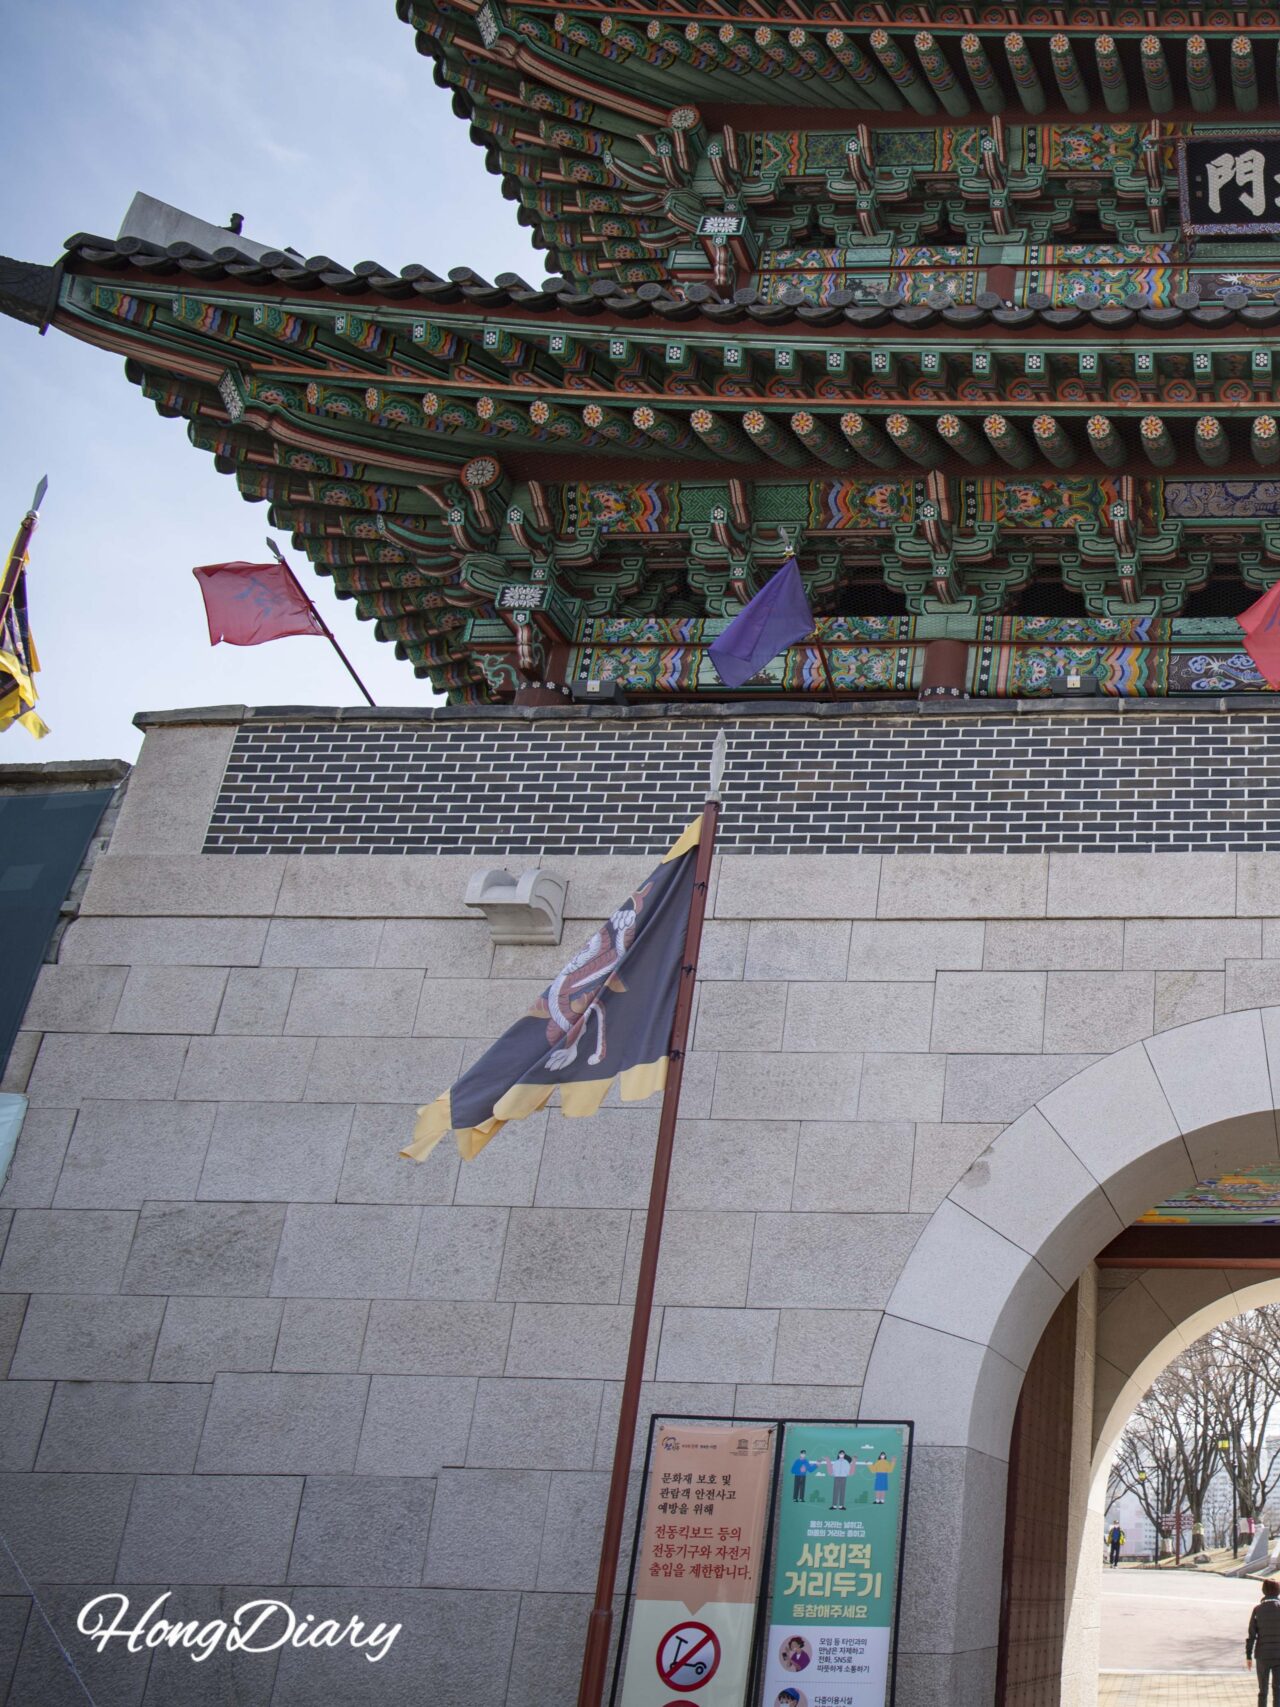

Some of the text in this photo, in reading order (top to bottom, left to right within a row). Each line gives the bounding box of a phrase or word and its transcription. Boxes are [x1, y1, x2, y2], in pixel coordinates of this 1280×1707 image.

[661, 1472, 732, 1486] 문화재 보호 및
[659, 1487, 736, 1501] 관람객 안전사고
[657, 1502, 714, 1515] 예방을 위해
[655, 1525, 742, 1542] 전동킥보드 등의
[652, 1543, 751, 1560] 전동기구와 자전거
[796, 1542, 872, 1569] 사회적
[649, 1562, 752, 1580] 출입을 제한합니다.
[783, 1571, 882, 1598] 거리두기
